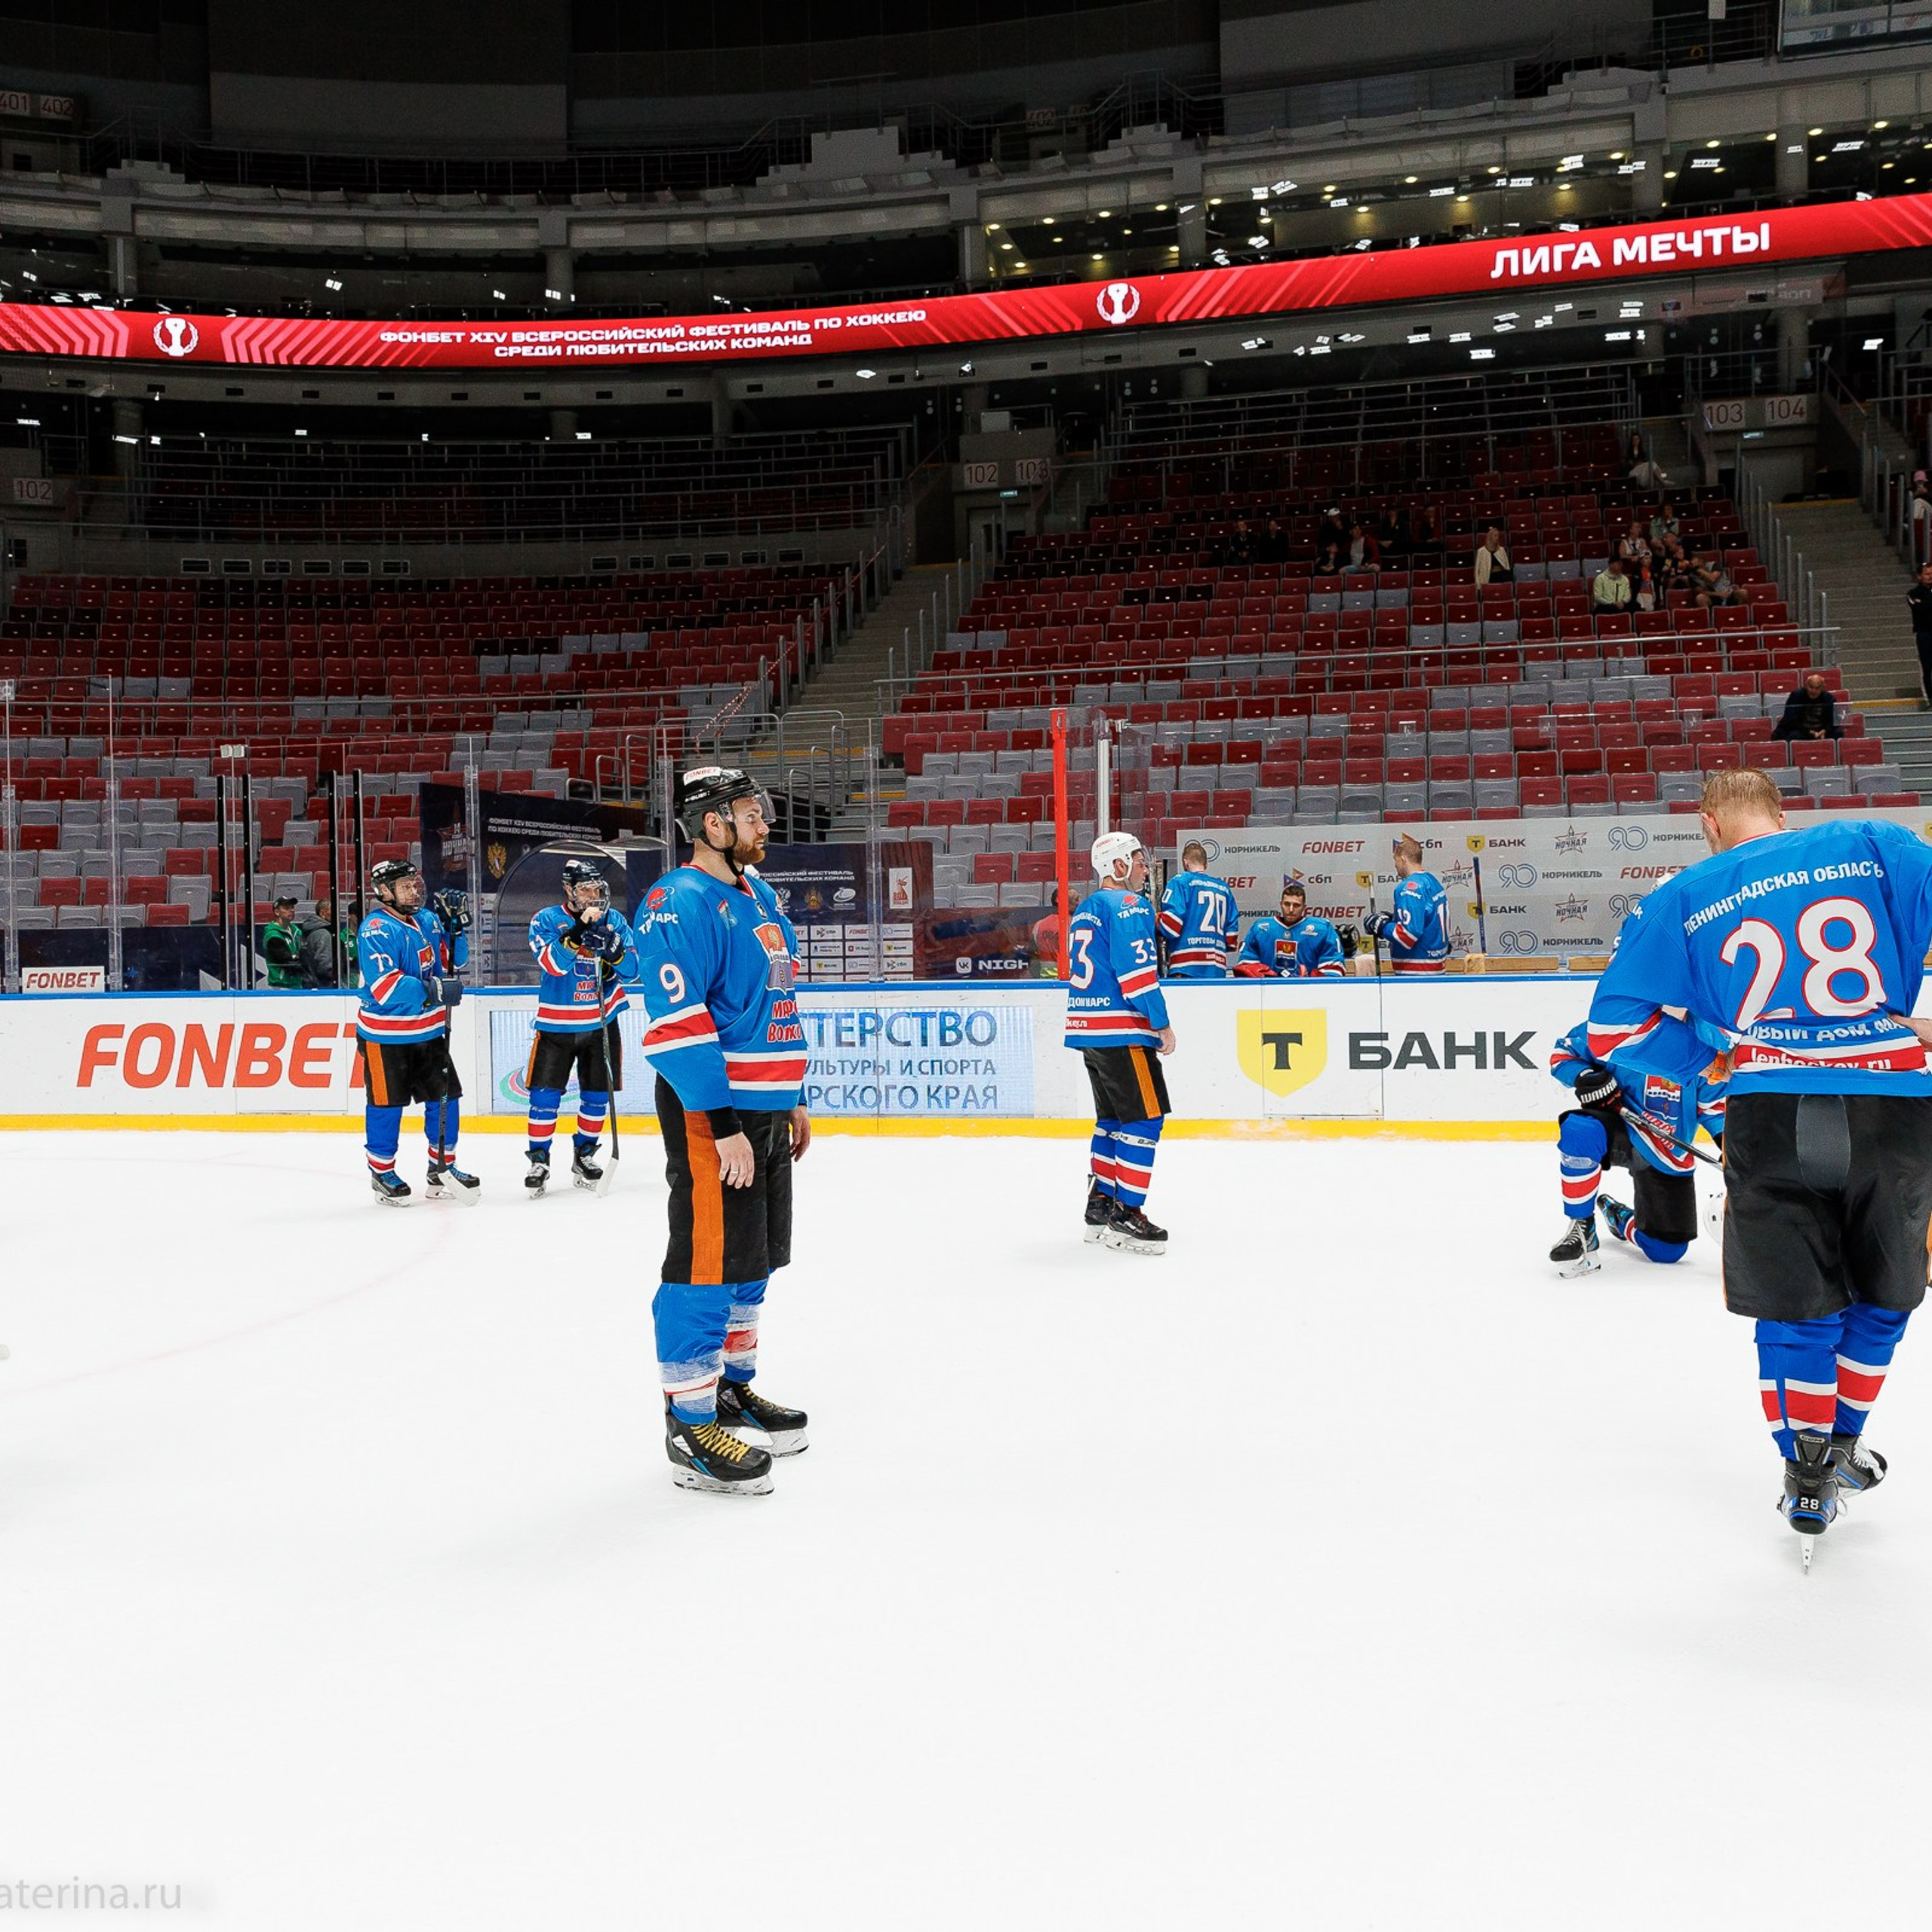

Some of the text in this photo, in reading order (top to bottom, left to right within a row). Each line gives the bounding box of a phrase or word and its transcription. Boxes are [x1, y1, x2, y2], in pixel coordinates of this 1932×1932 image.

[1491, 222, 1770, 278] ЛИГА МЕЧТЫ
[380, 310, 927, 343] ФОНБЕТ XIV ВСЕРОССИЙСКИЙ ФЕСТИВАЛЬ ПО ХОККЕЮ
[494, 334, 812, 357] СРЕДИ ЛЮБИТЕЛЬСКИХ КОМАНД
[1706, 404, 1744, 424] 103
[1767, 398, 1805, 420] 104
[967, 464, 997, 483] 102
[17, 480, 51, 500] 102
[1224, 845, 1281, 854] НОРНИКЕЛЬ
[1302, 841, 1365, 854] FONBET
[1489, 838, 1526, 847] БАНК
[1308, 874, 1332, 884] сбп
[1542, 870, 1602, 879] НОРНИКЕЛЬ
[1814, 860, 1884, 881] ОБЛАСЬ
[1198, 891, 1227, 936] 20
[1303, 906, 1367, 918] FONBET
[1490, 906, 1527, 914] БАНК
[1131, 938, 1157, 964] 33
[1543, 937, 1604, 946] НОРНИКЕЛЬ
[1069, 928, 1095, 991] 3
[1719, 896, 1887, 1032] 28
[26, 971, 101, 989] FONBET
[659, 961, 686, 1004] 9
[801, 1011, 998, 1048] ТЕРСТВО
[1262, 1031, 1539, 1070] Т БАНК
[900, 1060, 913, 1075] И
[918, 1059, 996, 1075] СПОРТА
[927, 1084, 998, 1109] КРАЯ
[1800, 1497, 1820, 1510] 28
